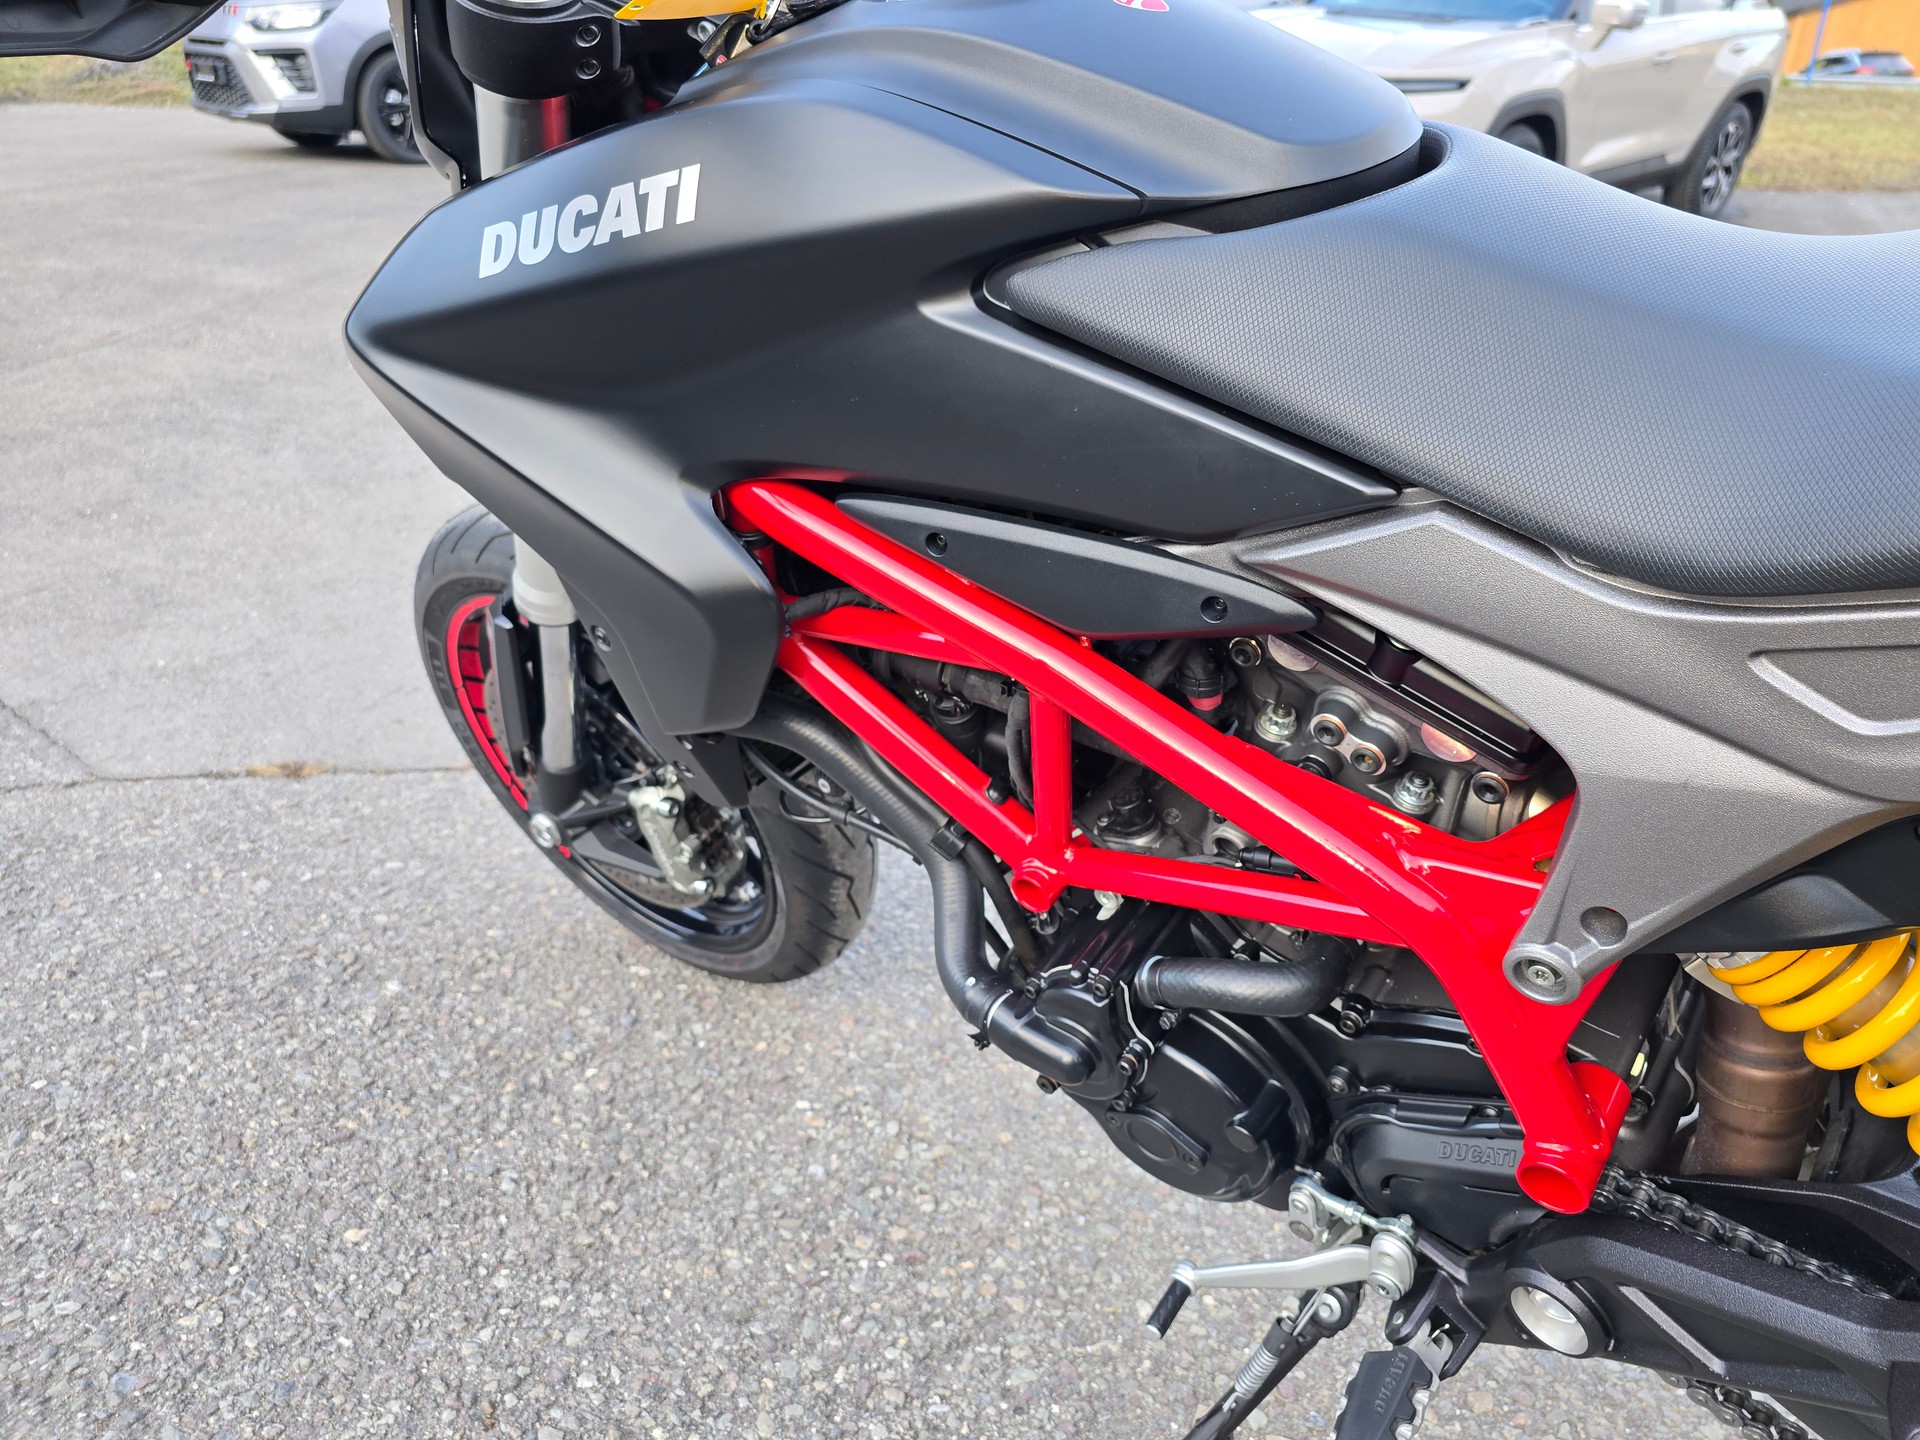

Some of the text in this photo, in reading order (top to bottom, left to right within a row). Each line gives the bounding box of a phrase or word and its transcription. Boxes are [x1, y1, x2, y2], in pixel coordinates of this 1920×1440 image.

[478, 163, 701, 279] DUCATI
[1438, 1141, 1517, 1168] DUCATI
[1373, 1352, 1409, 1416] DUCATI
